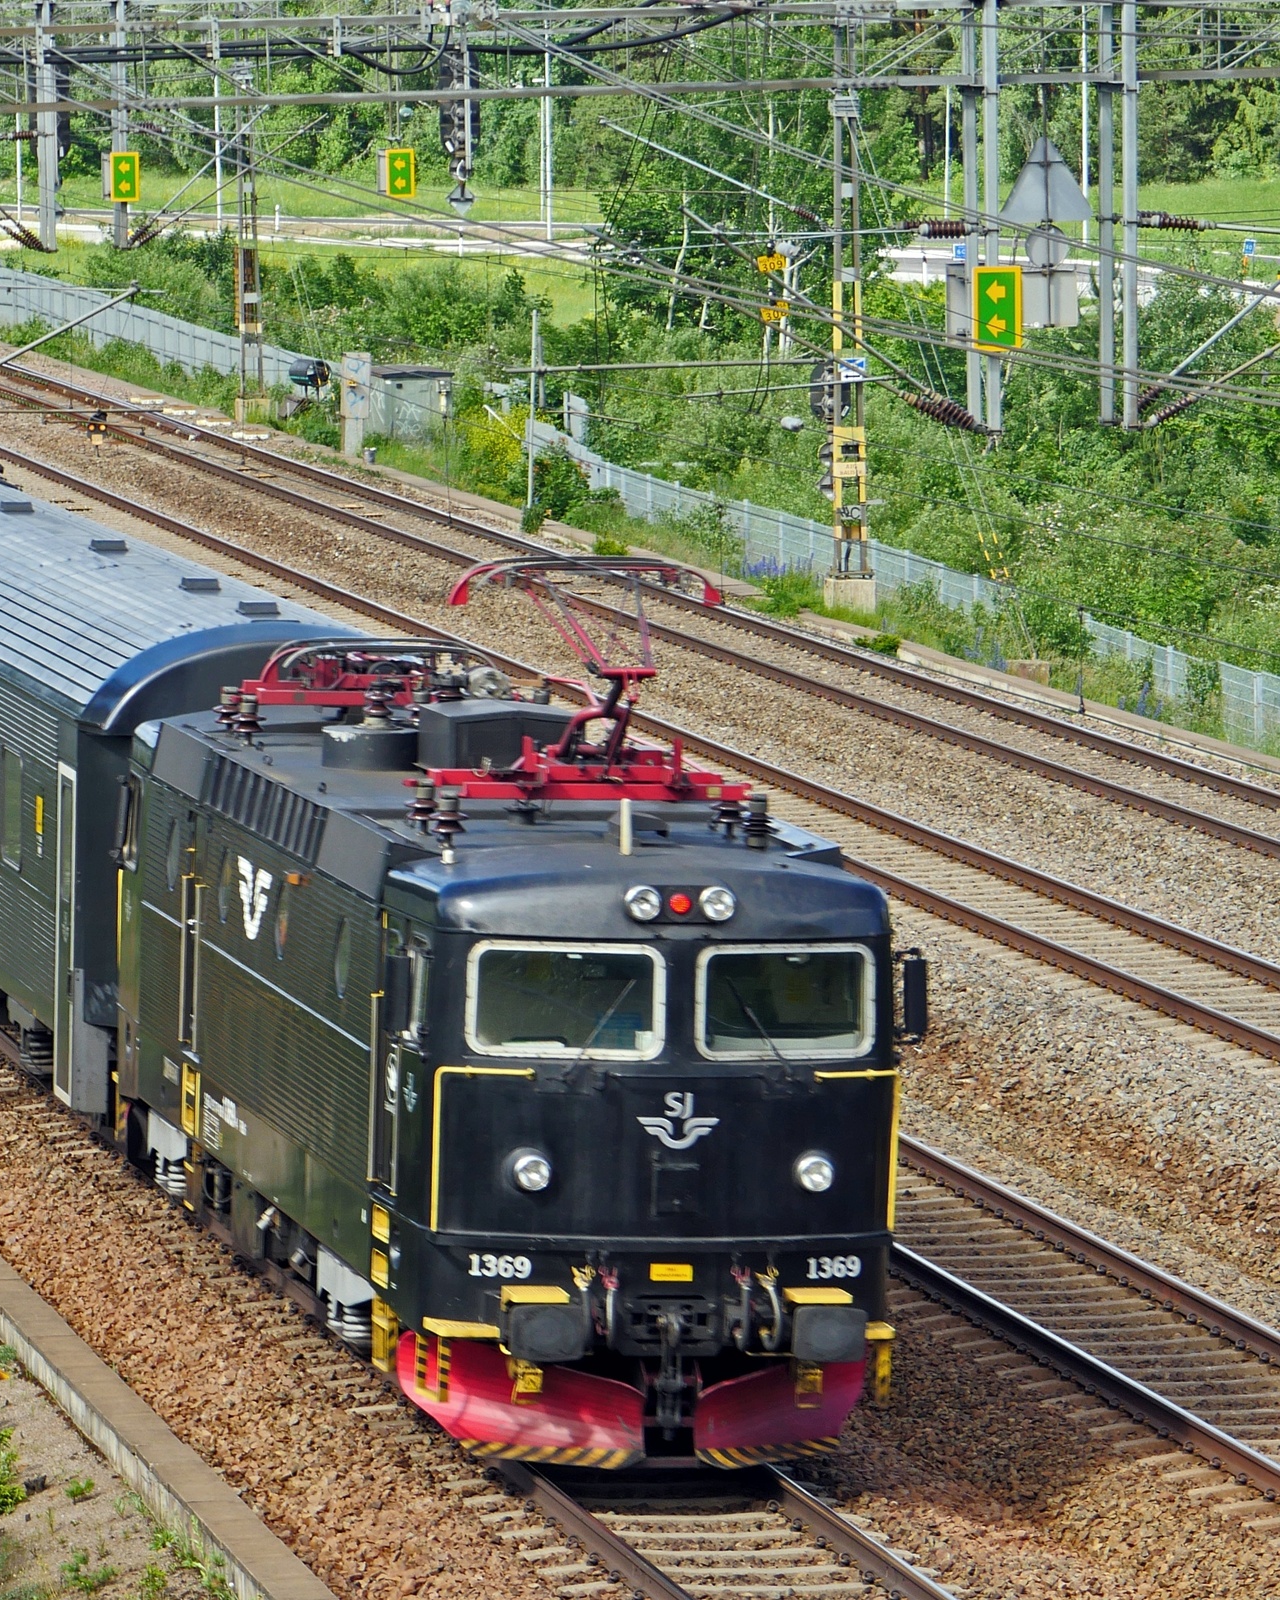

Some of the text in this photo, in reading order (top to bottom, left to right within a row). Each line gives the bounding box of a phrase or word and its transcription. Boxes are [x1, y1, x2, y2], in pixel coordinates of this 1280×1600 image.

[761, 260, 783, 272] 309
[663, 1091, 695, 1119] SJ
[468, 1253, 533, 1280] 1369
[806, 1254, 862, 1280] 1369
